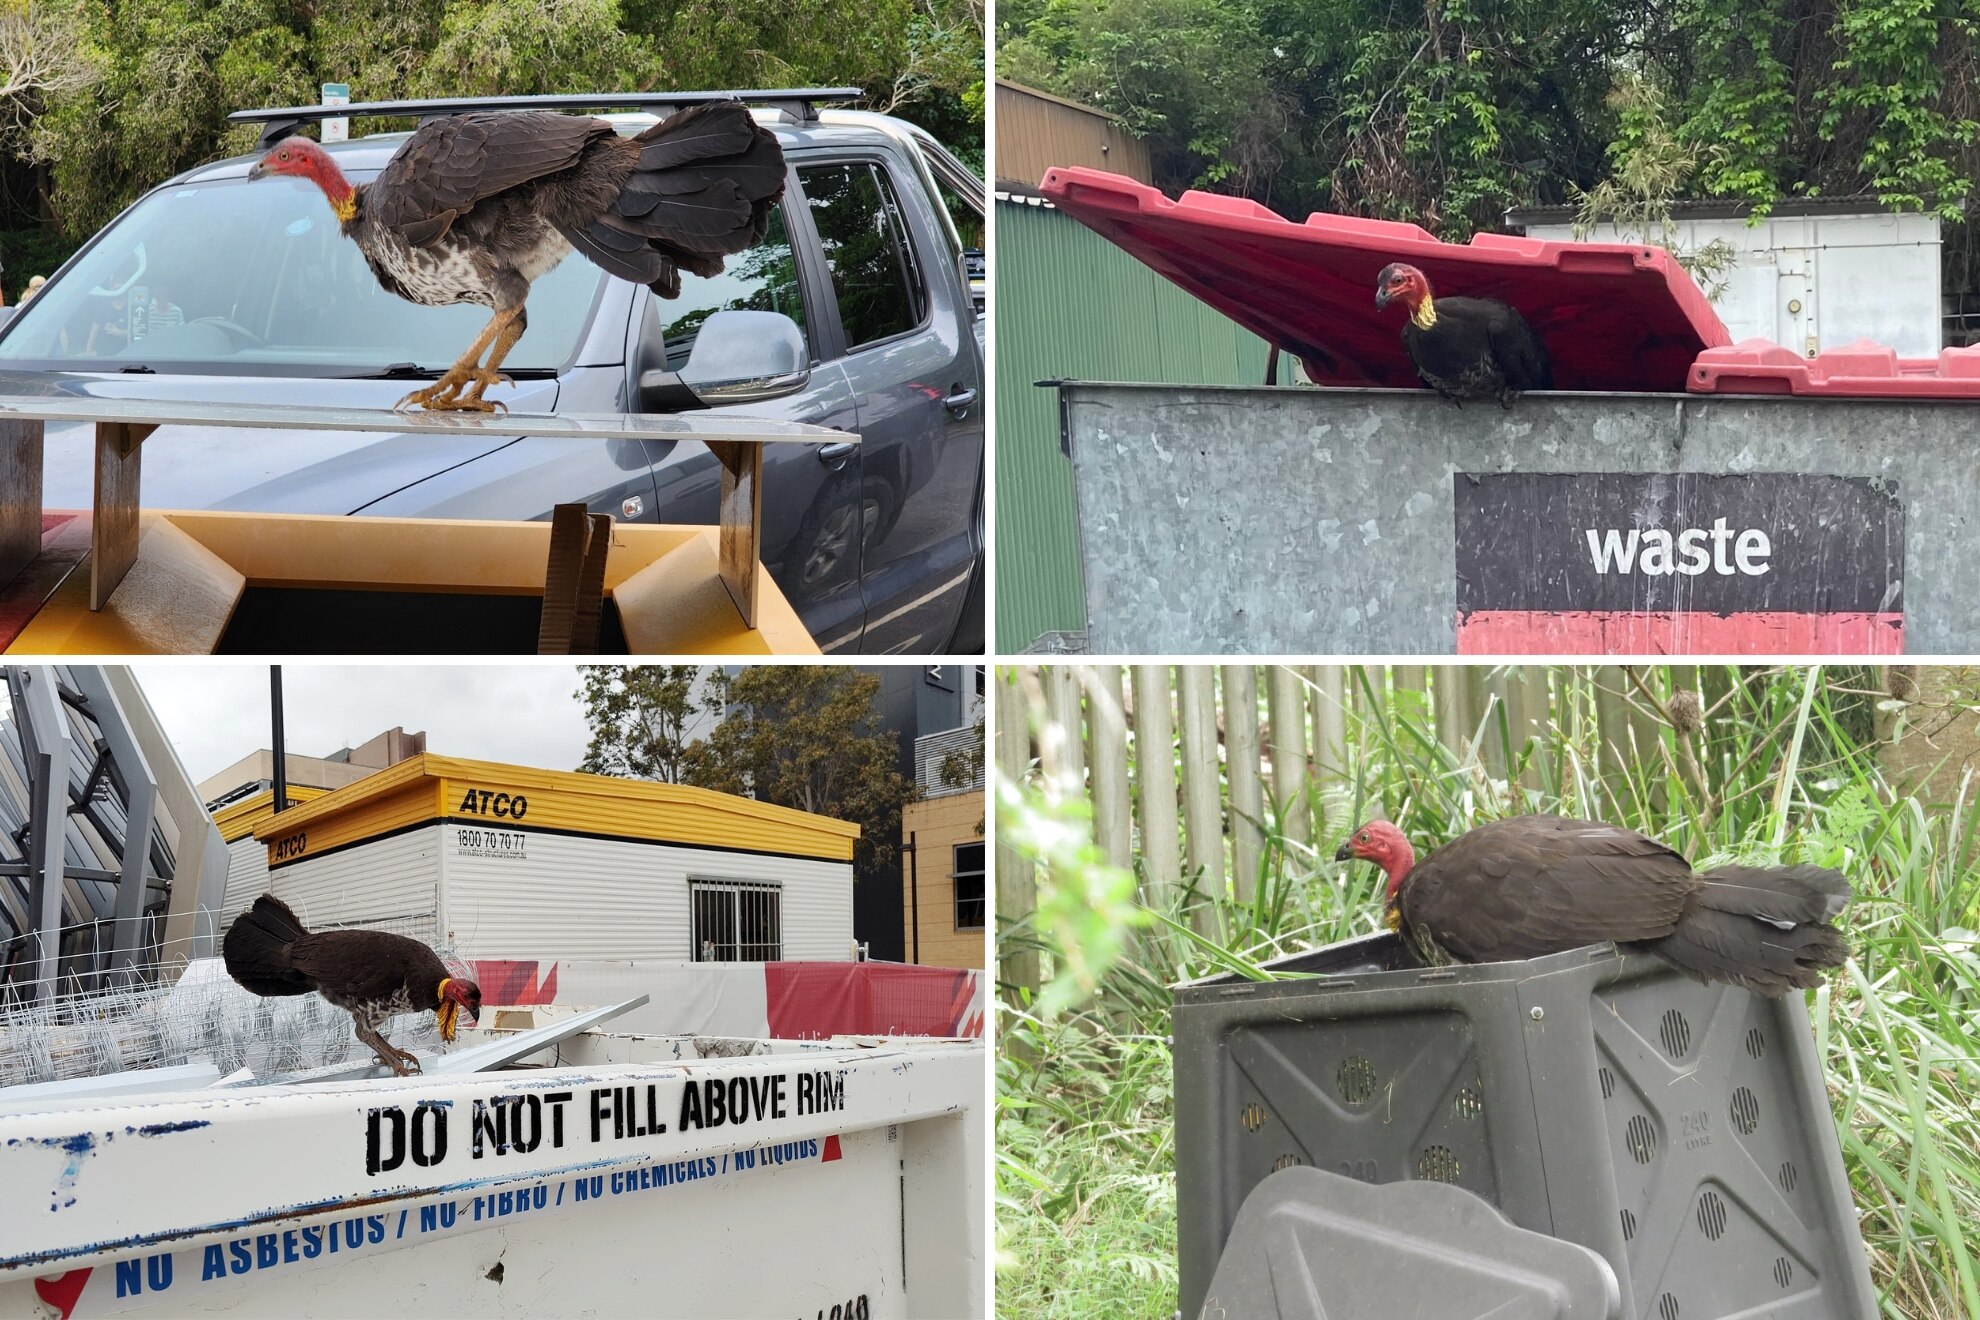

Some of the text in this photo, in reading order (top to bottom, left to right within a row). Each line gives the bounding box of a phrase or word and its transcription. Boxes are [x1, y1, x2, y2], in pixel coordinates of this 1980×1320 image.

[1585, 516, 1772, 576] waste
[459, 788, 528, 819] ATCO
[275, 832, 307, 861] ATCO
[457, 829, 526, 850] 1800 70 70 77
[366, 1069, 845, 1176] DO NOT FILL ABOVE RIM
[1680, 1109, 1711, 1136] 240
[115, 1252, 174, 1299] NO
[201, 1214, 386, 1282] ASBESTOS
[420, 1201, 456, 1233] NO
[574, 1174, 604, 1202] NO
[610, 1156, 717, 1195] CHEMICALS
[734, 1148, 756, 1171] NO
[760, 1138, 818, 1166] LIQUIDS
